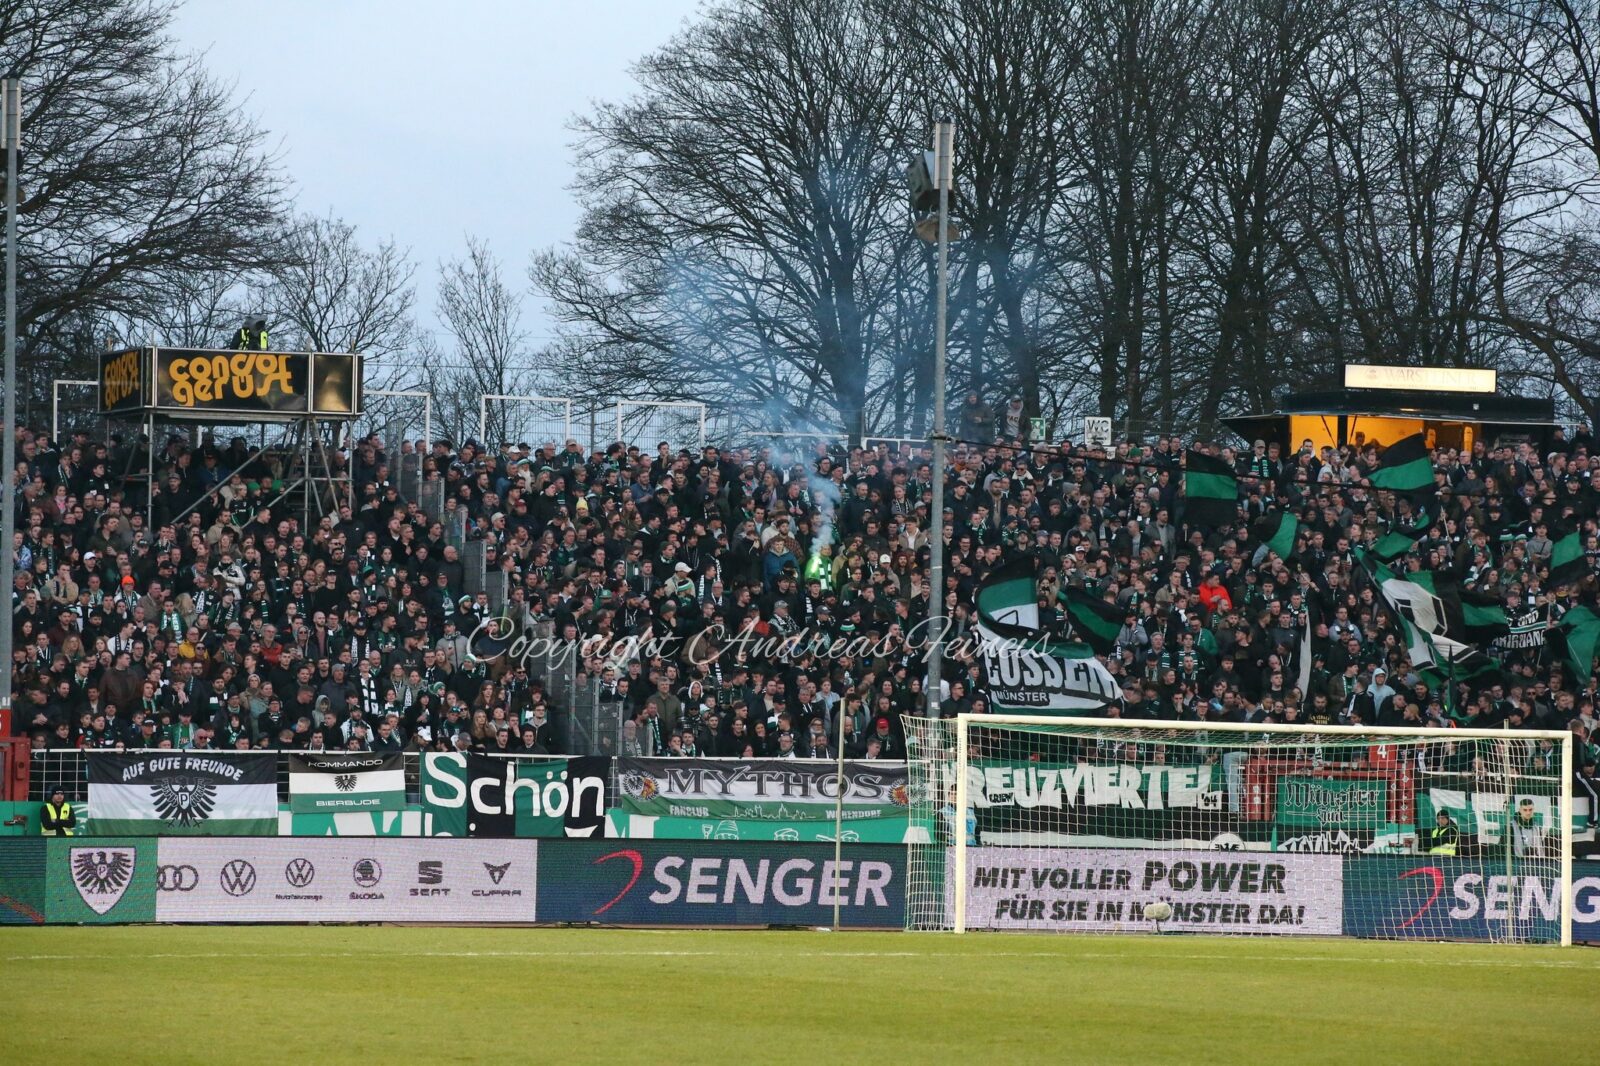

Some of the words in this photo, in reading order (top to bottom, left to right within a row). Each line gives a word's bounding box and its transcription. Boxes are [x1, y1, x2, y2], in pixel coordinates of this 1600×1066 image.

[1087, 419, 1109, 433] WC
[995, 689, 1048, 702] MÜNSTER
[1377, 744, 1387, 759] 4
[122, 762, 145, 782] AUF
[149, 757, 181, 773] GUTE
[185, 757, 244, 782] FREUNDE
[308, 759, 383, 768] KOMMANDO
[425, 752, 605, 818] Schön
[665, 765, 886, 799] MYTHOS
[316, 799, 380, 807] BIERBUDE
[669, 804, 709, 817] FANCLUB
[649, 855, 893, 906] SENGER
[974, 867, 1026, 888] MIT
[1032, 868, 1131, 890] VOLLER
[1142, 861, 1286, 893] POWER
[409, 888, 451, 897] SEAT
[472, 889, 521, 897] CUPRA
[995, 894, 1045, 921] FÜR
[1050, 901, 1089, 922] SIE
[1095, 902, 1123, 921] IN
[1257, 904, 1305, 925] DA!
